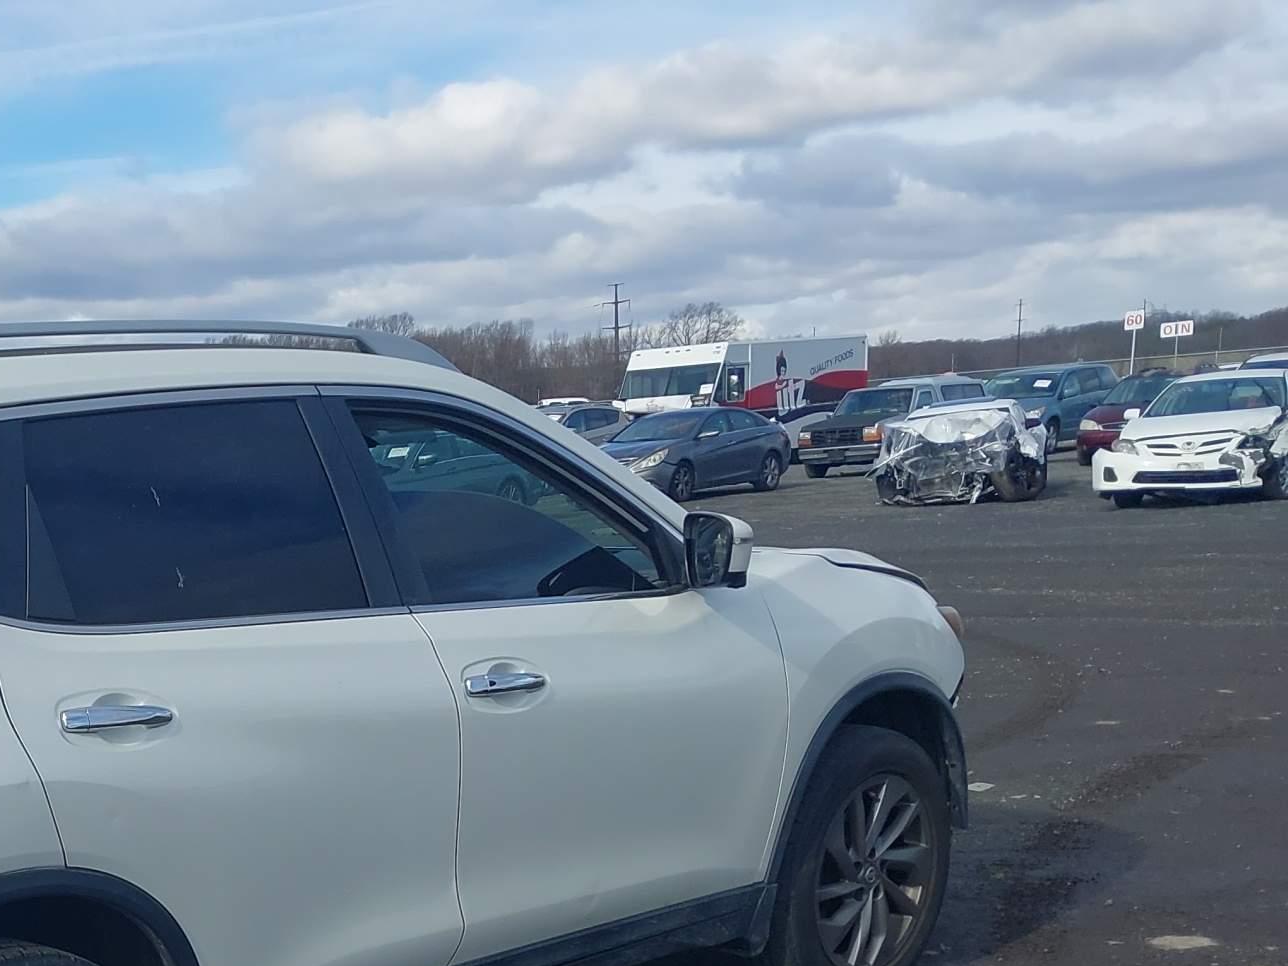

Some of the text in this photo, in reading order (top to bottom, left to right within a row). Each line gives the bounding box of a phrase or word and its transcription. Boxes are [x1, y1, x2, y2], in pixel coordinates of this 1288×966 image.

[1126, 314, 1142, 326] 60
[810, 348, 854, 375] QUALITY FOODS
